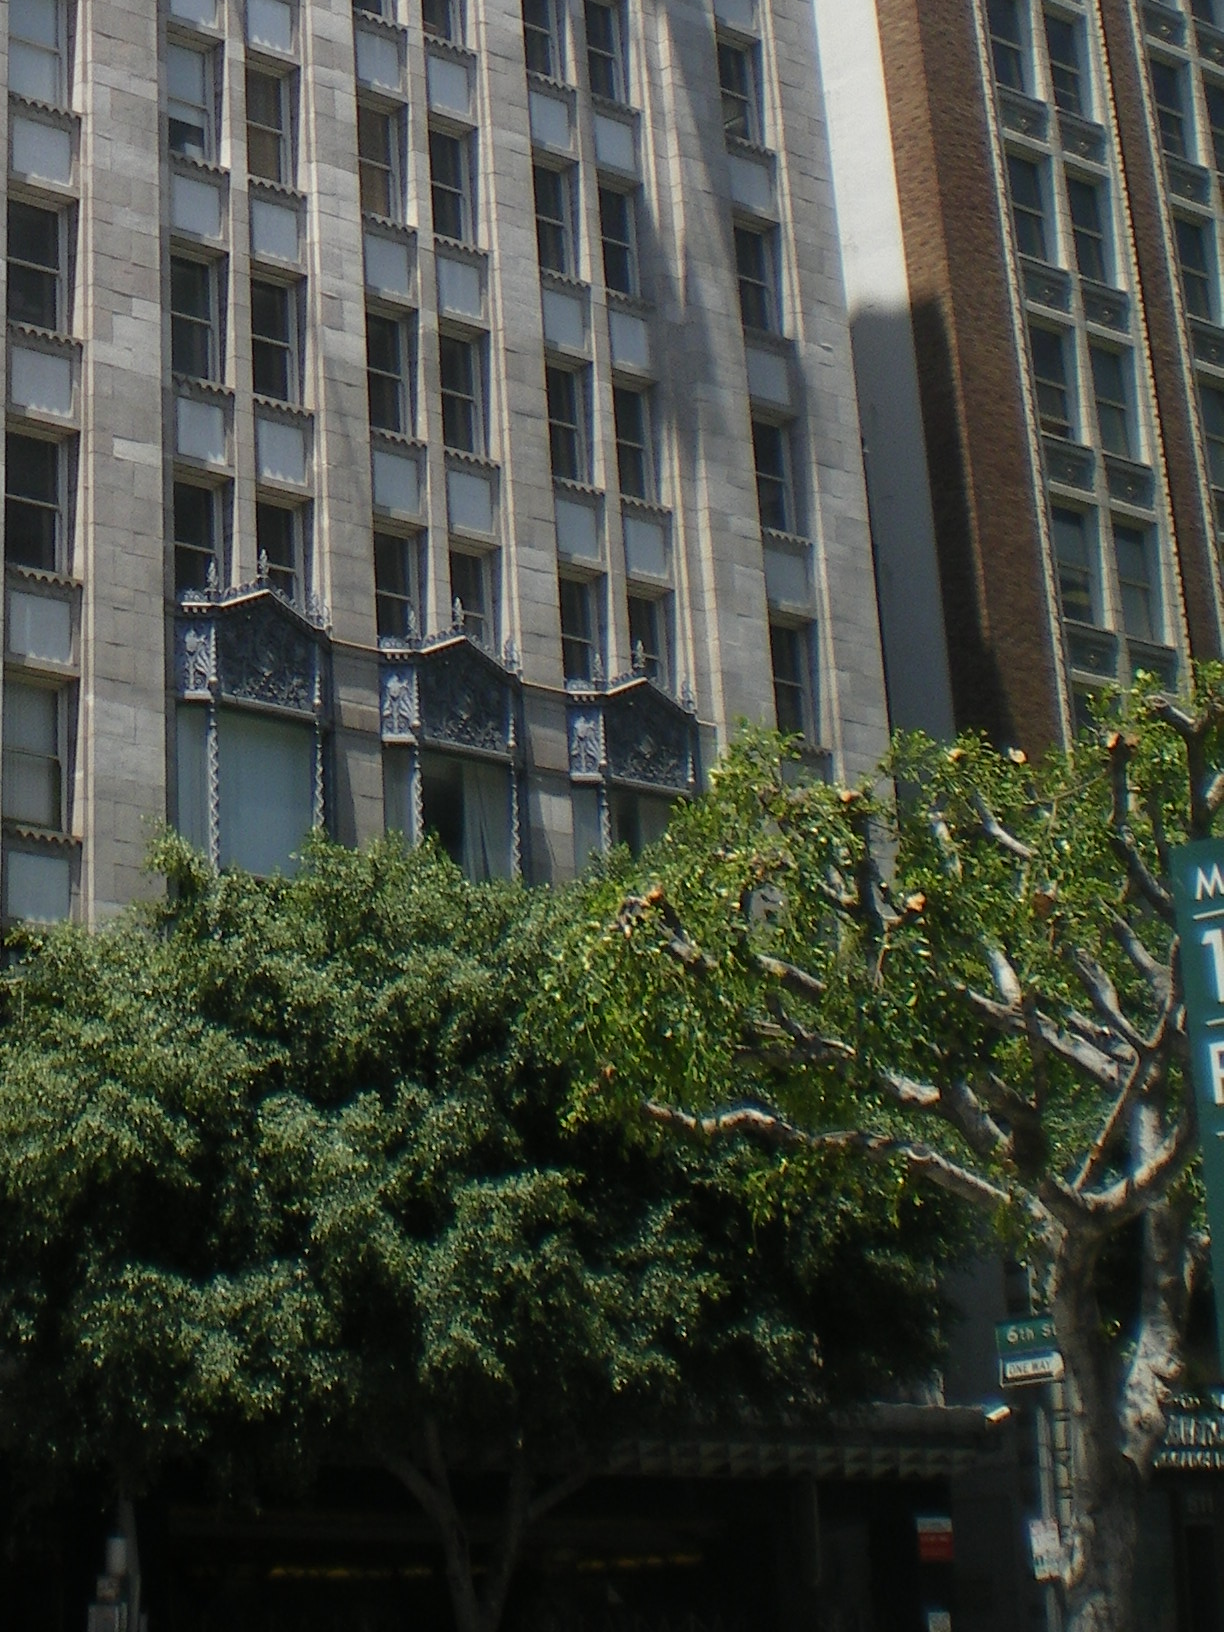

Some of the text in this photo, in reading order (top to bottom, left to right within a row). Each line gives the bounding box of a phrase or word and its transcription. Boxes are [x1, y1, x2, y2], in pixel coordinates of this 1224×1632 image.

[1007, 1325, 1035, 1345] 6th
[1009, 1359, 1051, 1375] ONE WAY
